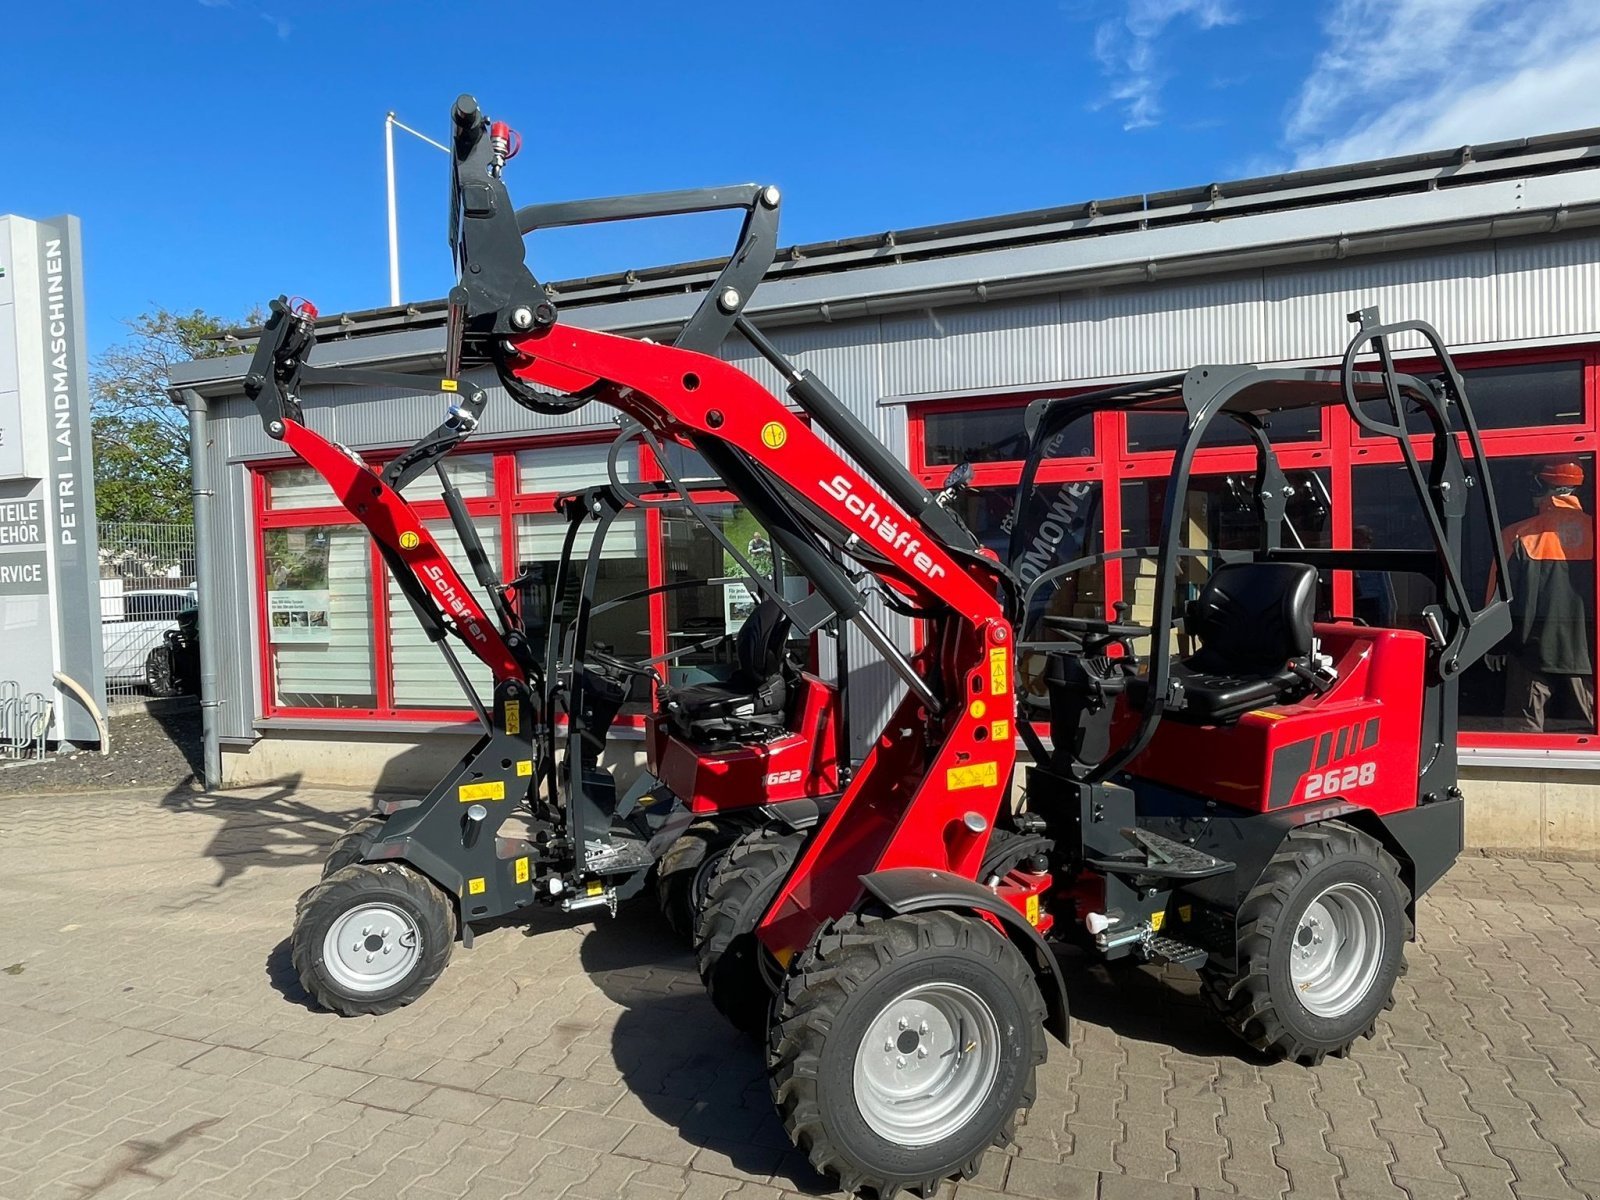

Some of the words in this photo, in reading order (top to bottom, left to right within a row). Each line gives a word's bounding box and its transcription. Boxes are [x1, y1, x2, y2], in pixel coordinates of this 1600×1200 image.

[46, 239, 73, 462] LANDMASCHINEN
[0, 502, 39, 522] TEILE
[58, 472, 77, 545] PETRI
[818, 475, 946, 579] Schäffer
[1019, 480, 1093, 584] OMOWE
[0, 564, 42, 583] RVICE
[422, 564, 487, 643] Schäffer
[1304, 762, 1377, 800] 2628
